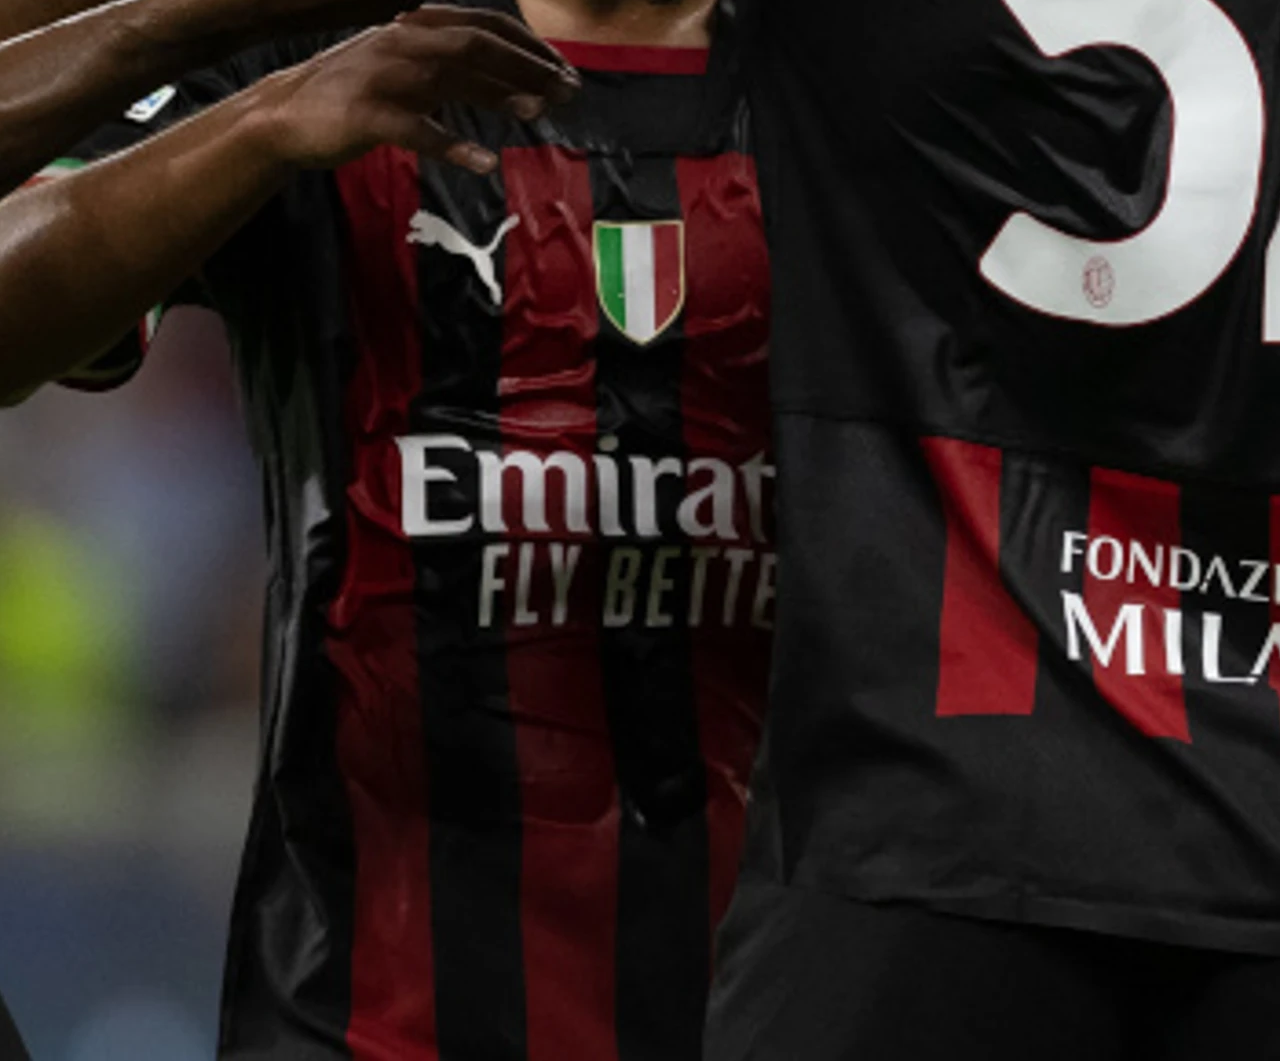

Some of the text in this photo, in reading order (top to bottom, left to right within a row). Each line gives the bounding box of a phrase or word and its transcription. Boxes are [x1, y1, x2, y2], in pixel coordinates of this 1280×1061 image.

[394, 435, 777, 543] Emirat
[477, 541, 778, 630] FLY BETTE
